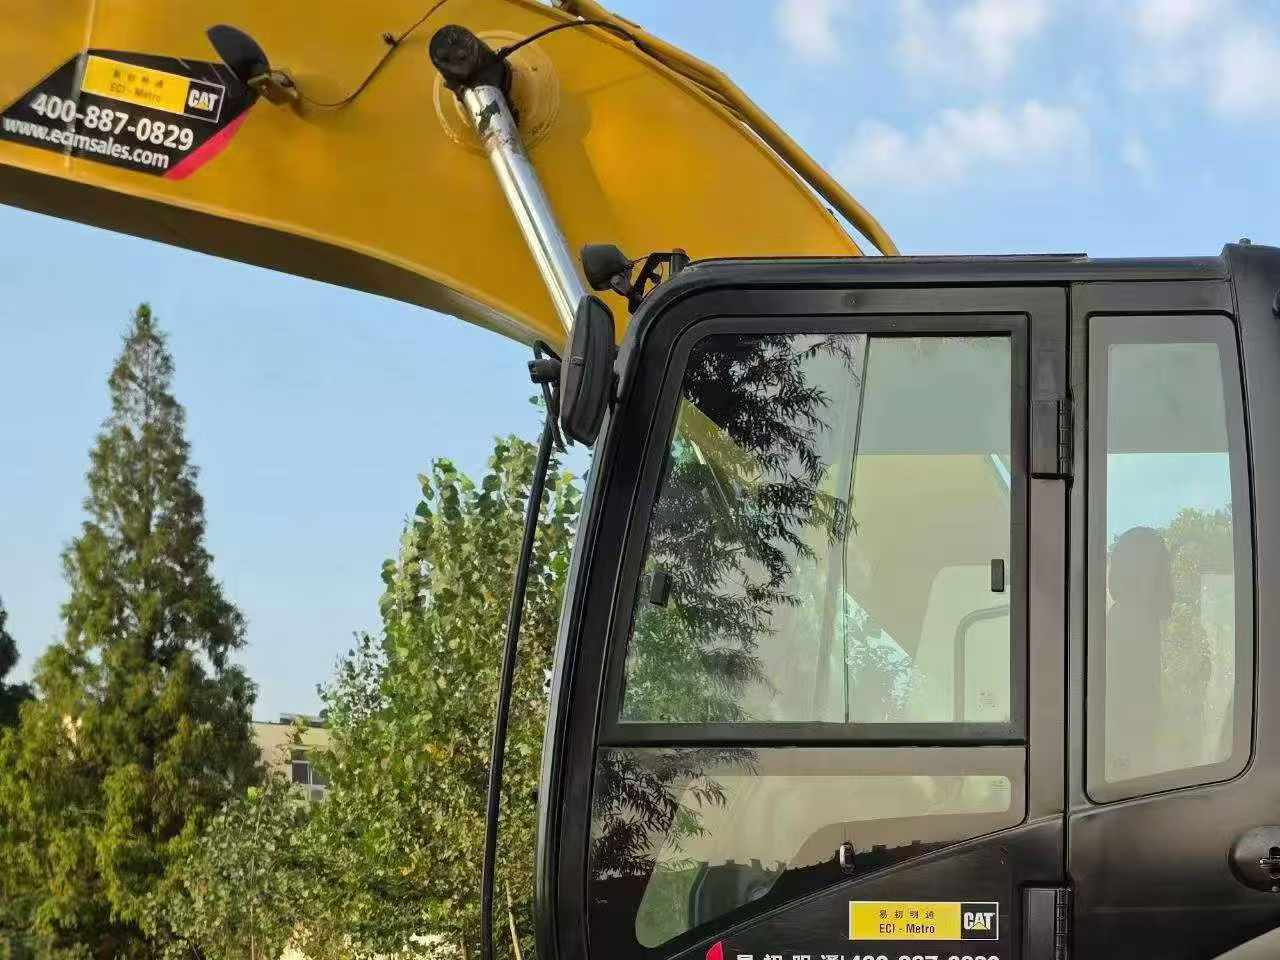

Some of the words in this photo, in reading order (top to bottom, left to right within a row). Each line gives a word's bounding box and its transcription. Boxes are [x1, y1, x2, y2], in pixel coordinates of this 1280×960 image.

[188, 89, 218, 111] CAT
[31, 93, 195, 151] 400-887-0829
[906, 923, 935, 934] Metro
[963, 911, 995, 930] CAT
